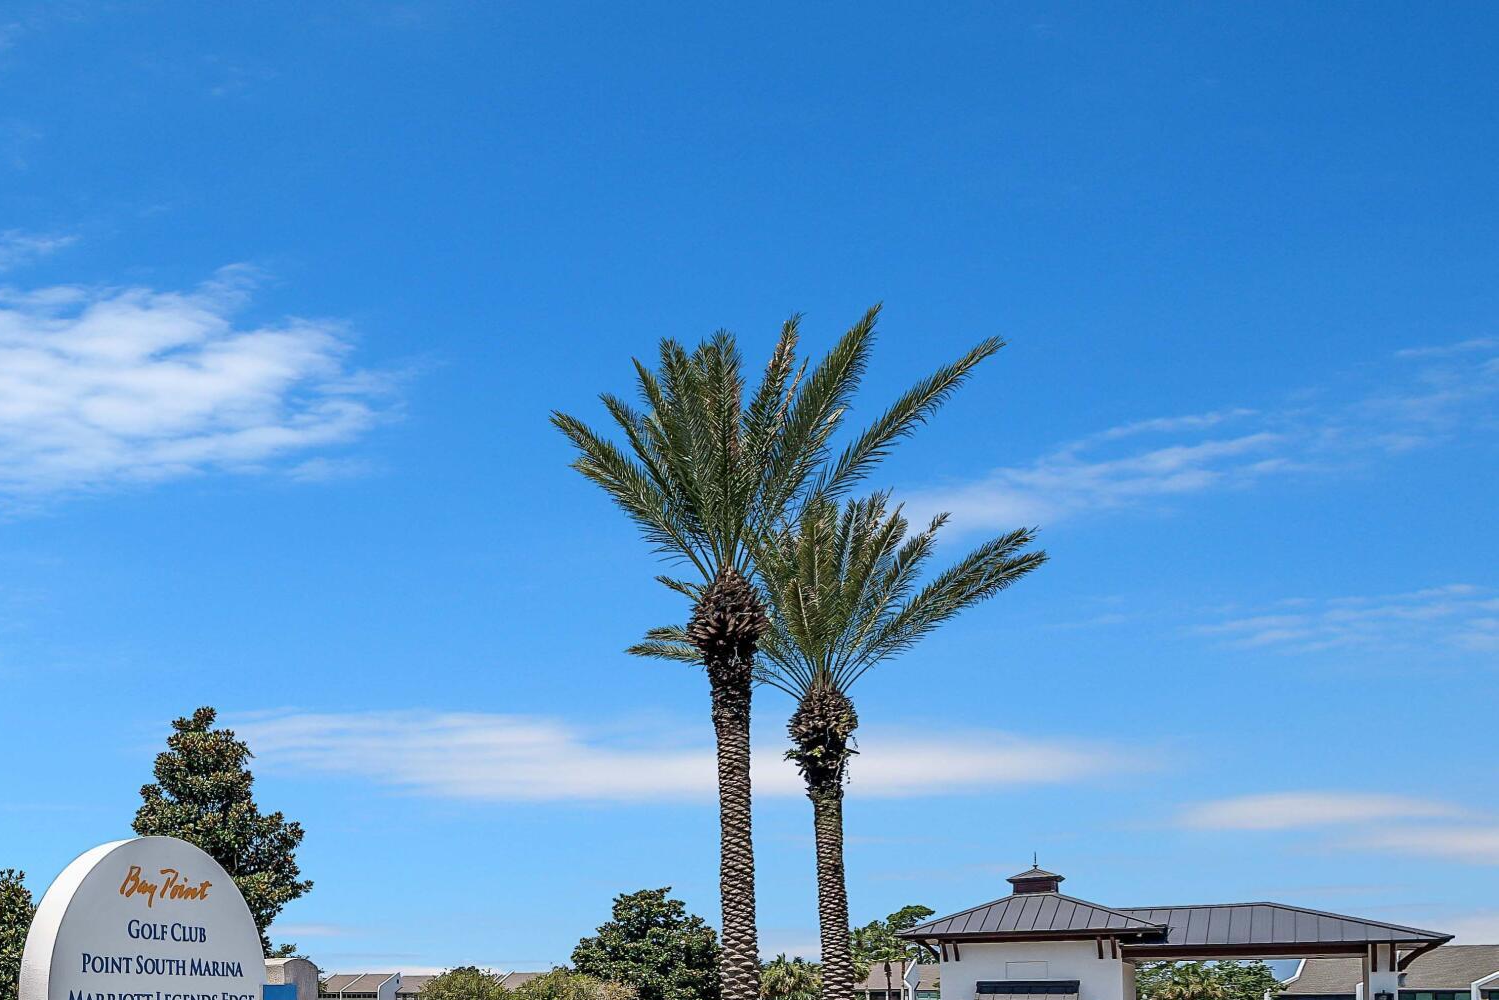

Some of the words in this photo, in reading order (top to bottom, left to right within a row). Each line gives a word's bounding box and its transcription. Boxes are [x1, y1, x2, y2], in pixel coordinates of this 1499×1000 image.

[119, 865, 158, 908] Bay
[160, 868, 213, 900] Point
[127, 919, 168, 941] GOLF
[170, 922, 207, 943] CLUB
[81, 953, 133, 974] POINT
[136, 955, 186, 976] SOUTH
[189, 957, 244, 978] MARINA
